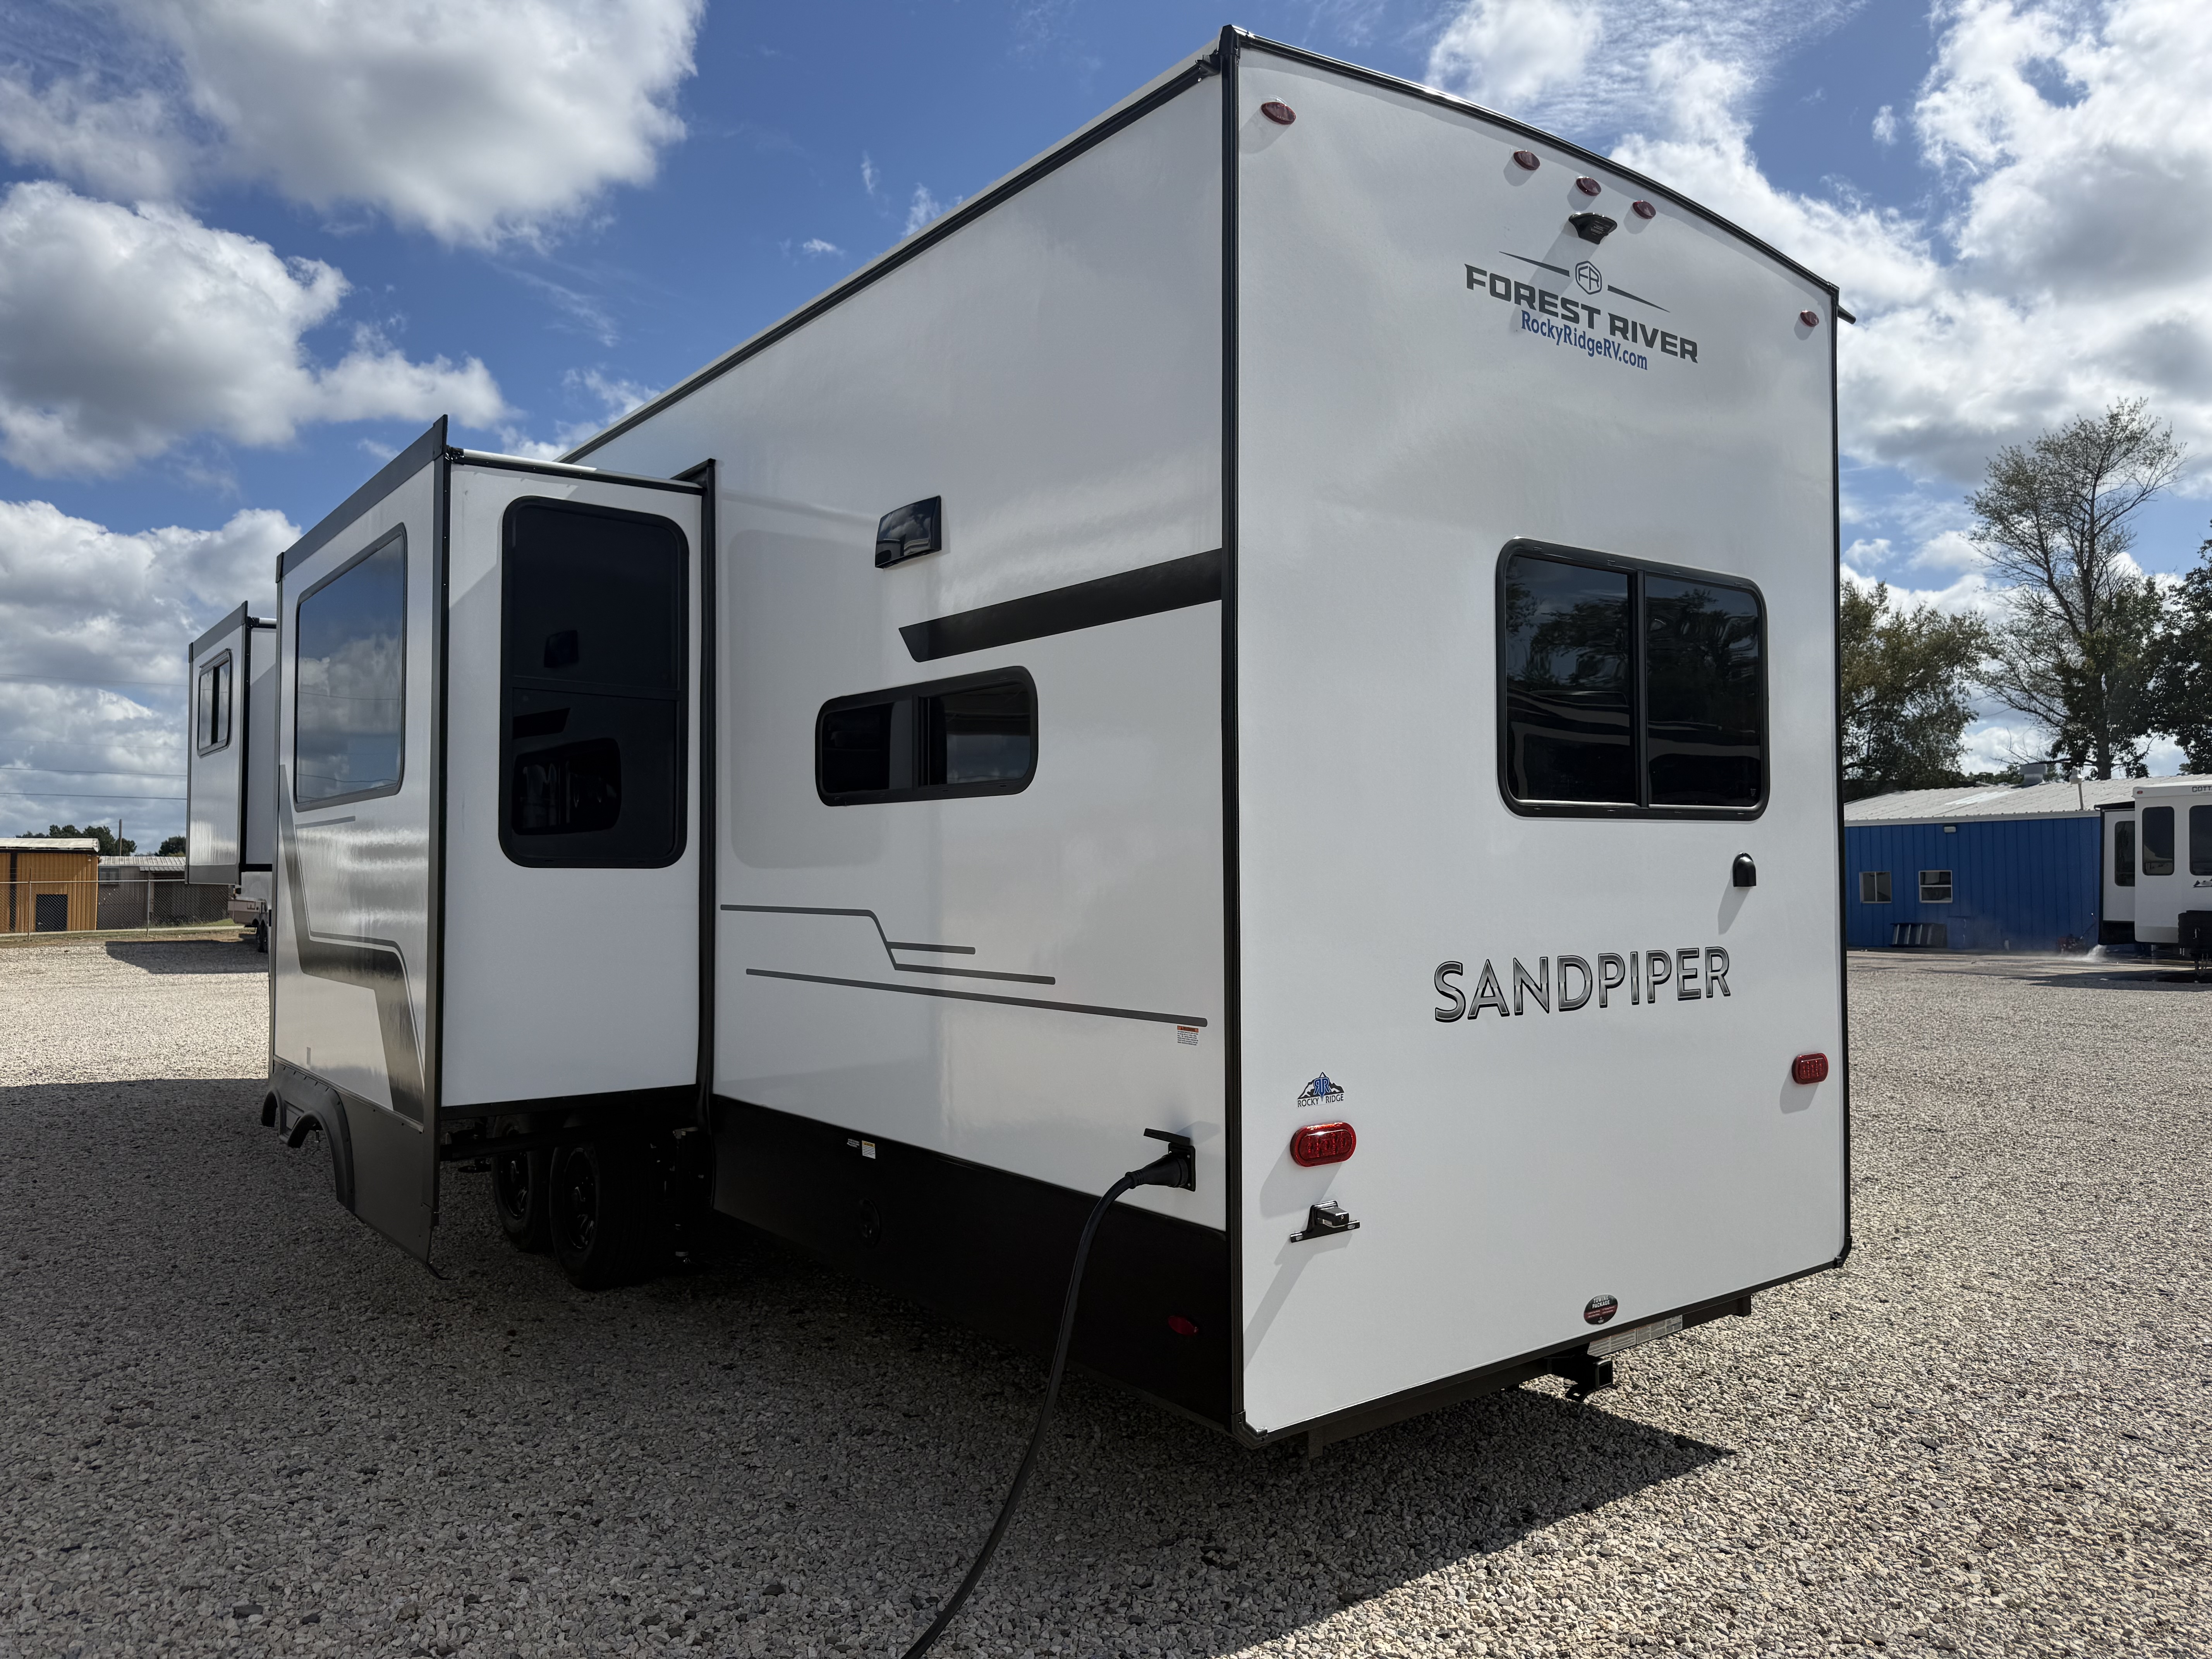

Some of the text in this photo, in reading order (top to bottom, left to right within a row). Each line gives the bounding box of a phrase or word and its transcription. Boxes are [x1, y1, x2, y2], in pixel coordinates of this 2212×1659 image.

[1464, 263, 1698, 363] FOREST RIVER
[1522, 310, 1647, 370] RockyRidgeRV.com
[1434, 946, 1730, 1023] SANDPIPER
[1298, 1094, 1344, 1108] ROCKY RIDGE
[1592, 1300, 1610, 1309] PACKAGE
[1594, 1295, 1609, 1304] TOWING
